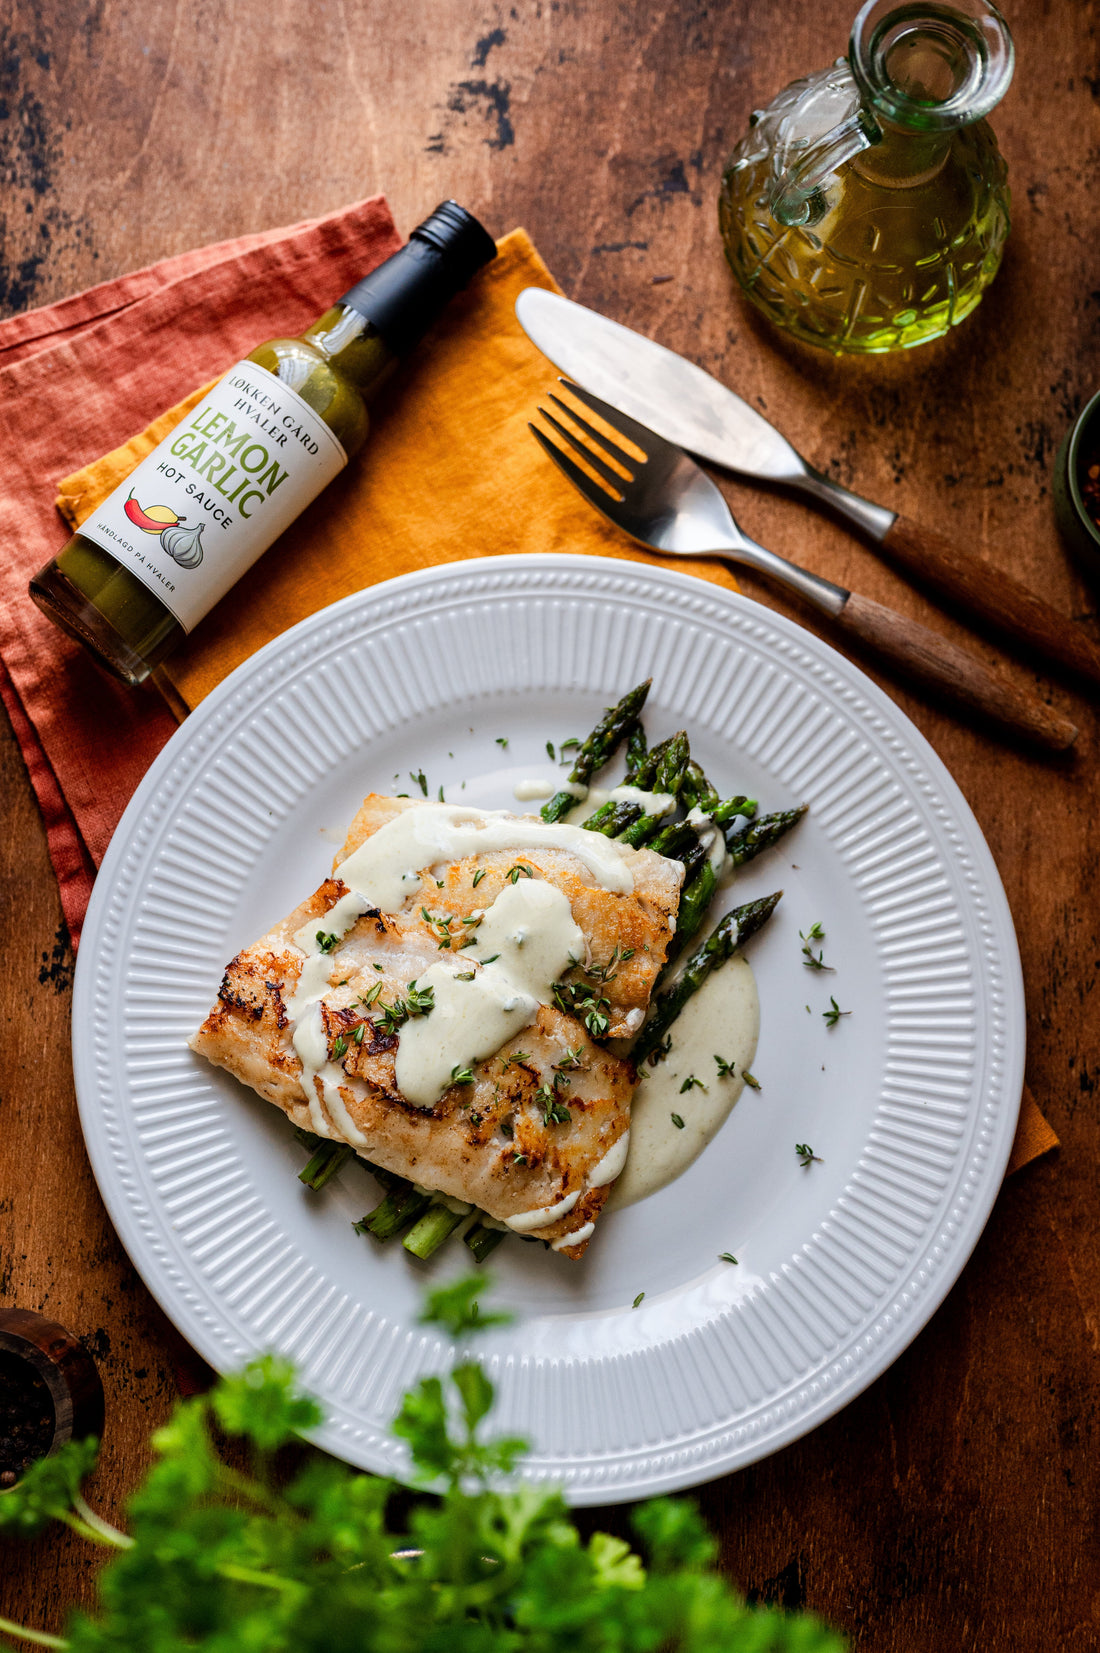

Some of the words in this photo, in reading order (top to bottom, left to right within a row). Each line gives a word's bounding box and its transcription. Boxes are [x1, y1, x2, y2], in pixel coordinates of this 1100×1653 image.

[190, 406, 290, 497] LEMON
[228, 375, 281, 416] LØKKEN
[282, 414, 320, 456] GÅRD
[233, 397, 289, 448] HVALER
[156, 461, 186, 485] HOT
[185, 483, 233, 530] SAUCE
[170, 432, 266, 519] GARLIC
[96, 521, 134, 553] HÅNDLAGD
[134, 550, 147, 564] PÅ
[146, 561, 177, 593] HVALER
